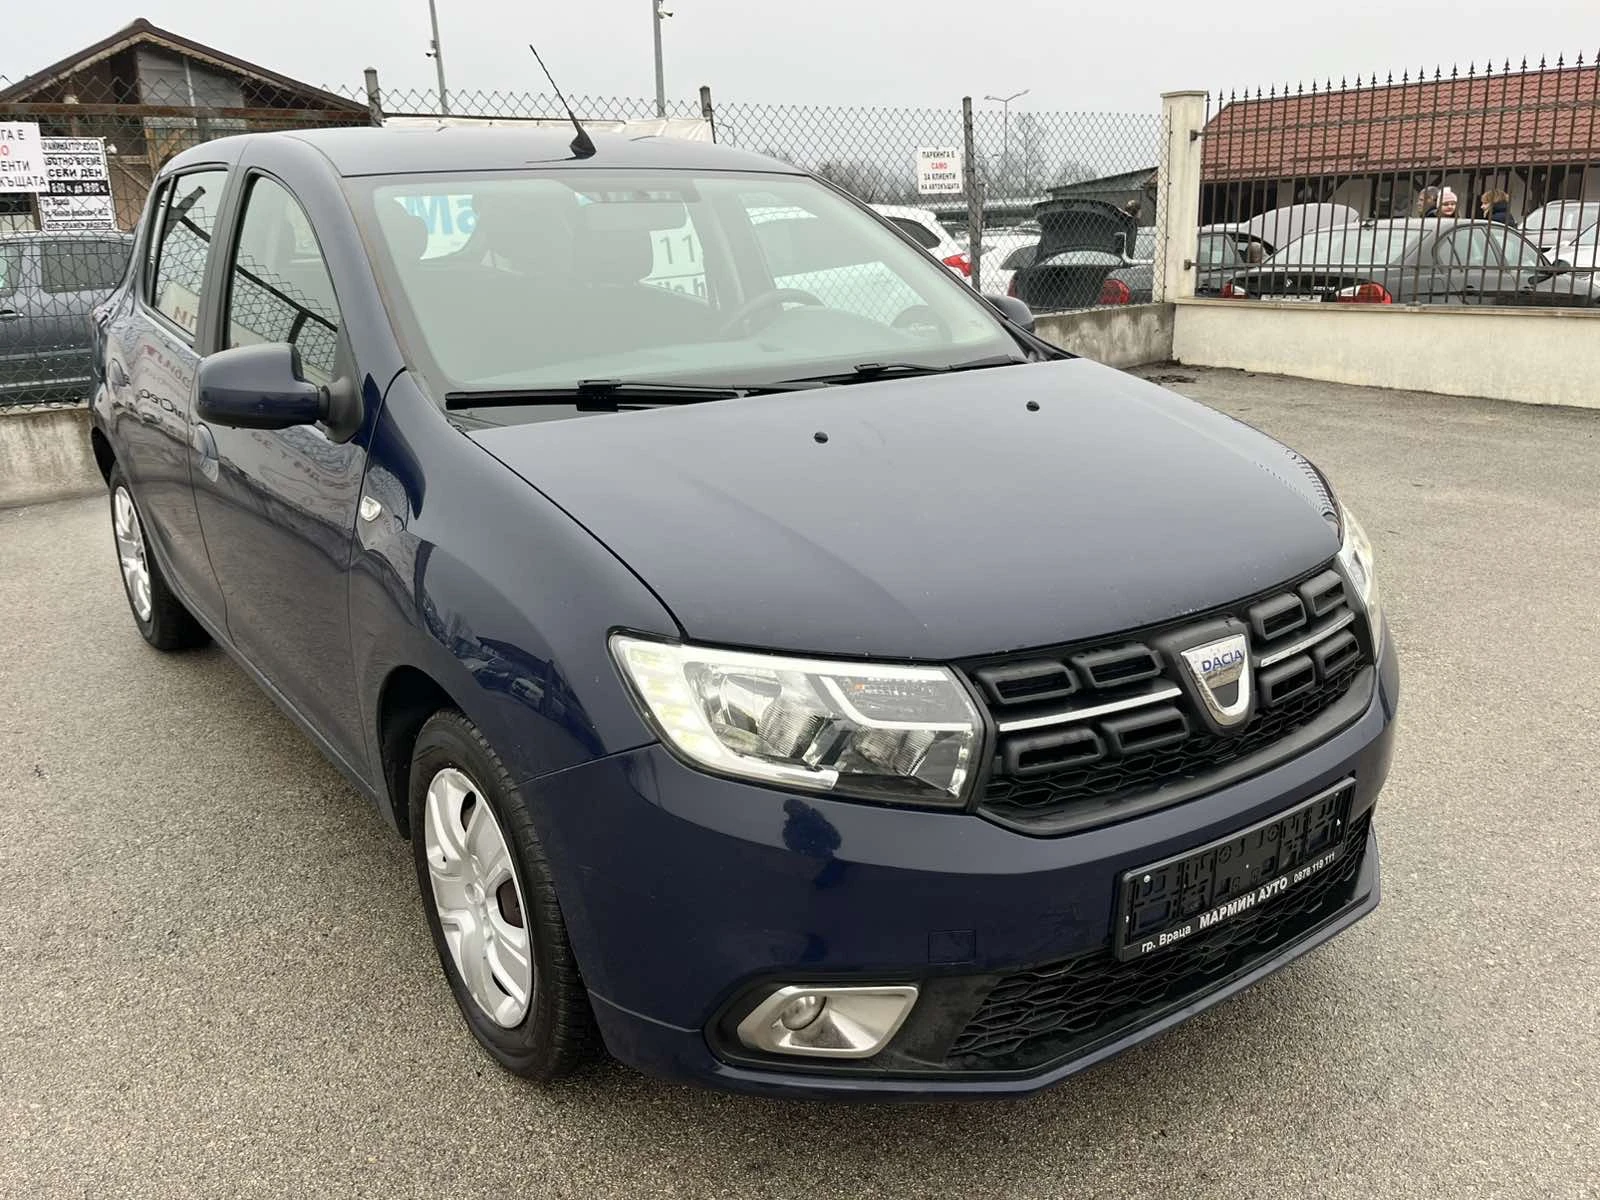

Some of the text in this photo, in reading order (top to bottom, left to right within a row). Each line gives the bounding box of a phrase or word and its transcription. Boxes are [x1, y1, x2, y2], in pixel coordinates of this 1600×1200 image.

[18, 129, 25, 140] Е
[931, 162, 948, 170] САМО
[81, 168, 103, 178] ДЕН
[1202, 649, 1244, 672] DACIA
[1141, 941, 1156, 953] гр.
[1159, 925, 1192, 945] Враца
[1199, 893, 1255, 929] МАРМИН
[1258, 876, 1288, 903] АУТО
[1325, 851, 1335, 864] 111
